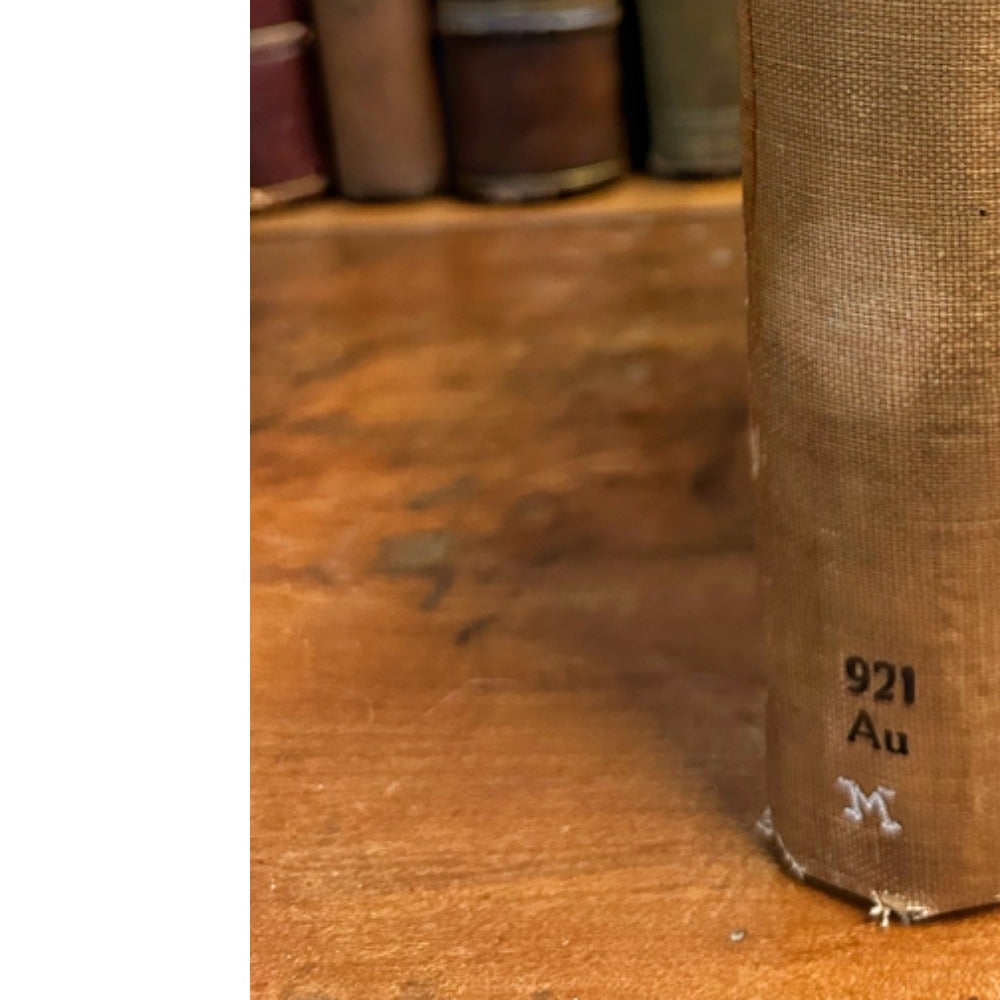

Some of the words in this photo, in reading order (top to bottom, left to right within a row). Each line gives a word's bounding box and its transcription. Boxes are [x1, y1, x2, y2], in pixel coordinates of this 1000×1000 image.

[845, 656, 916, 705] 921
[847, 709, 909, 755] Au
[834, 775, 902, 834] M
